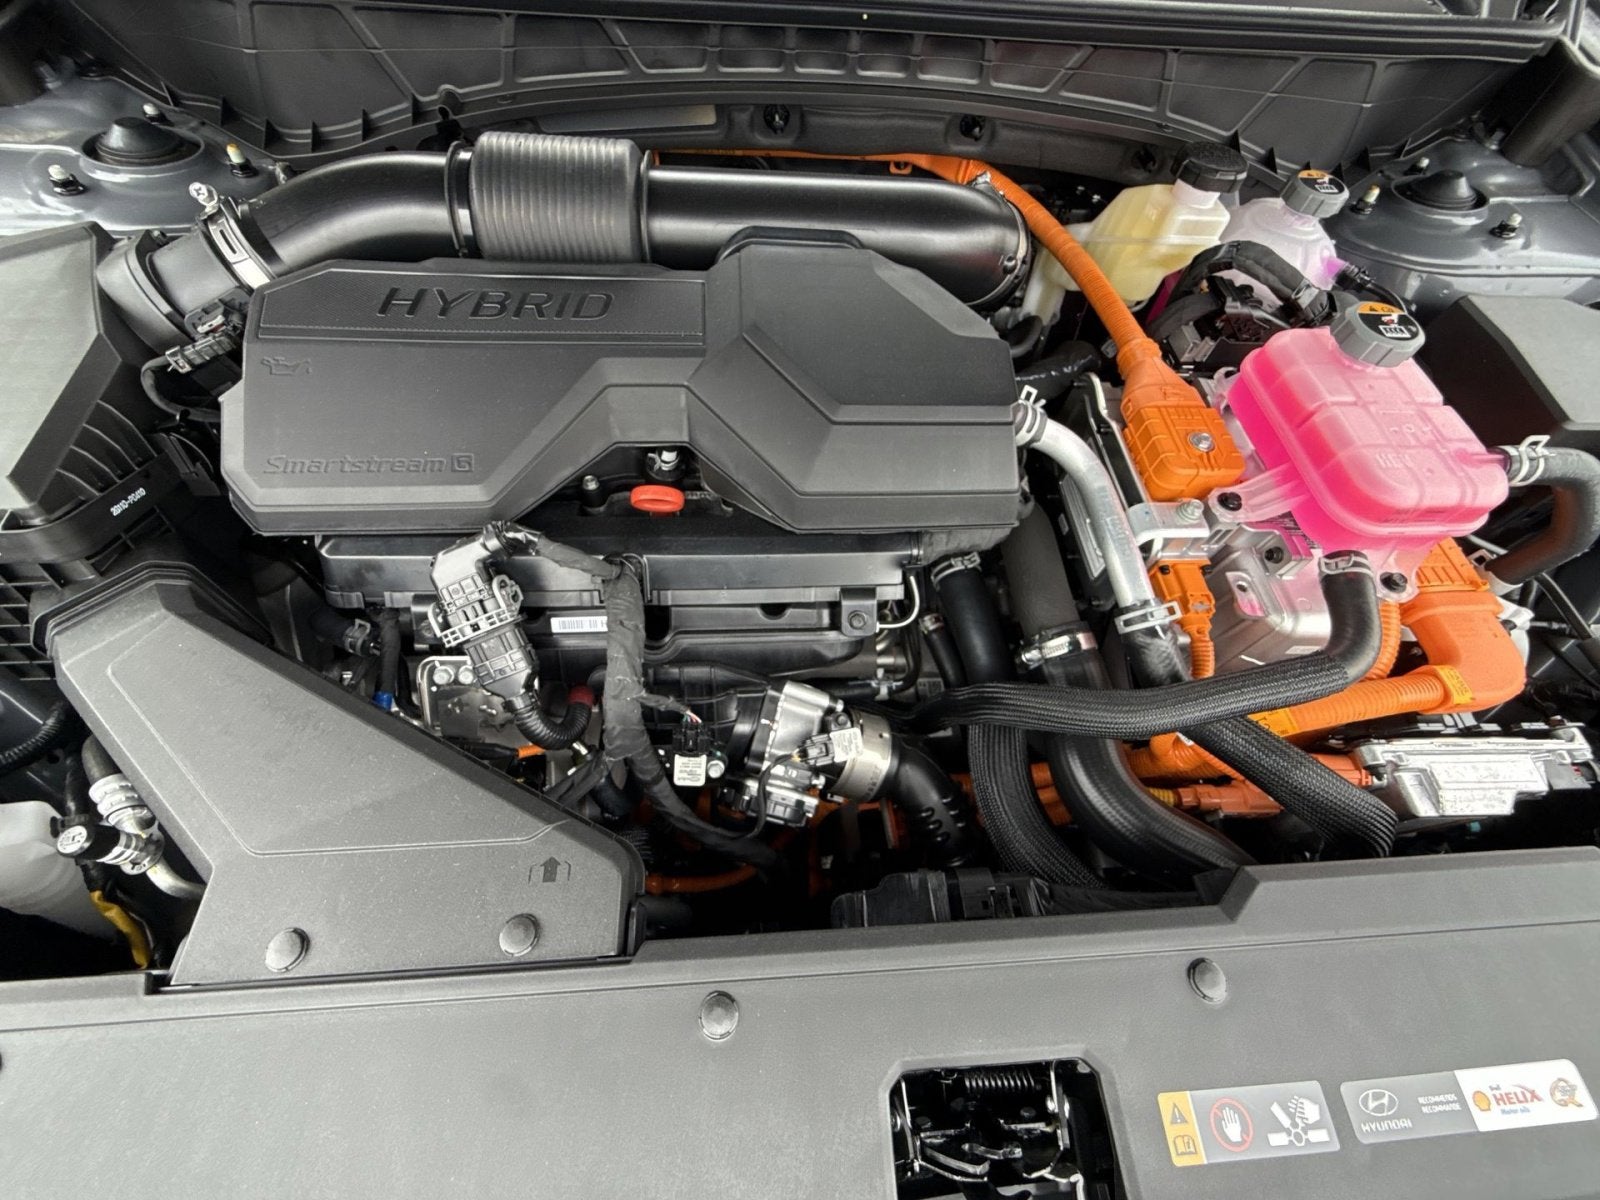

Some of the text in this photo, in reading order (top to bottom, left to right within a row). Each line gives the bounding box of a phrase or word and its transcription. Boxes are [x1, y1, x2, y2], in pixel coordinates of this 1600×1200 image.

[377, 287, 614, 321] HYBRID
[263, 455, 447, 474] Smartstream
[1492, 1088, 1543, 1106] HELIX
[1361, 1117, 1413, 1133] HYUNDAI
